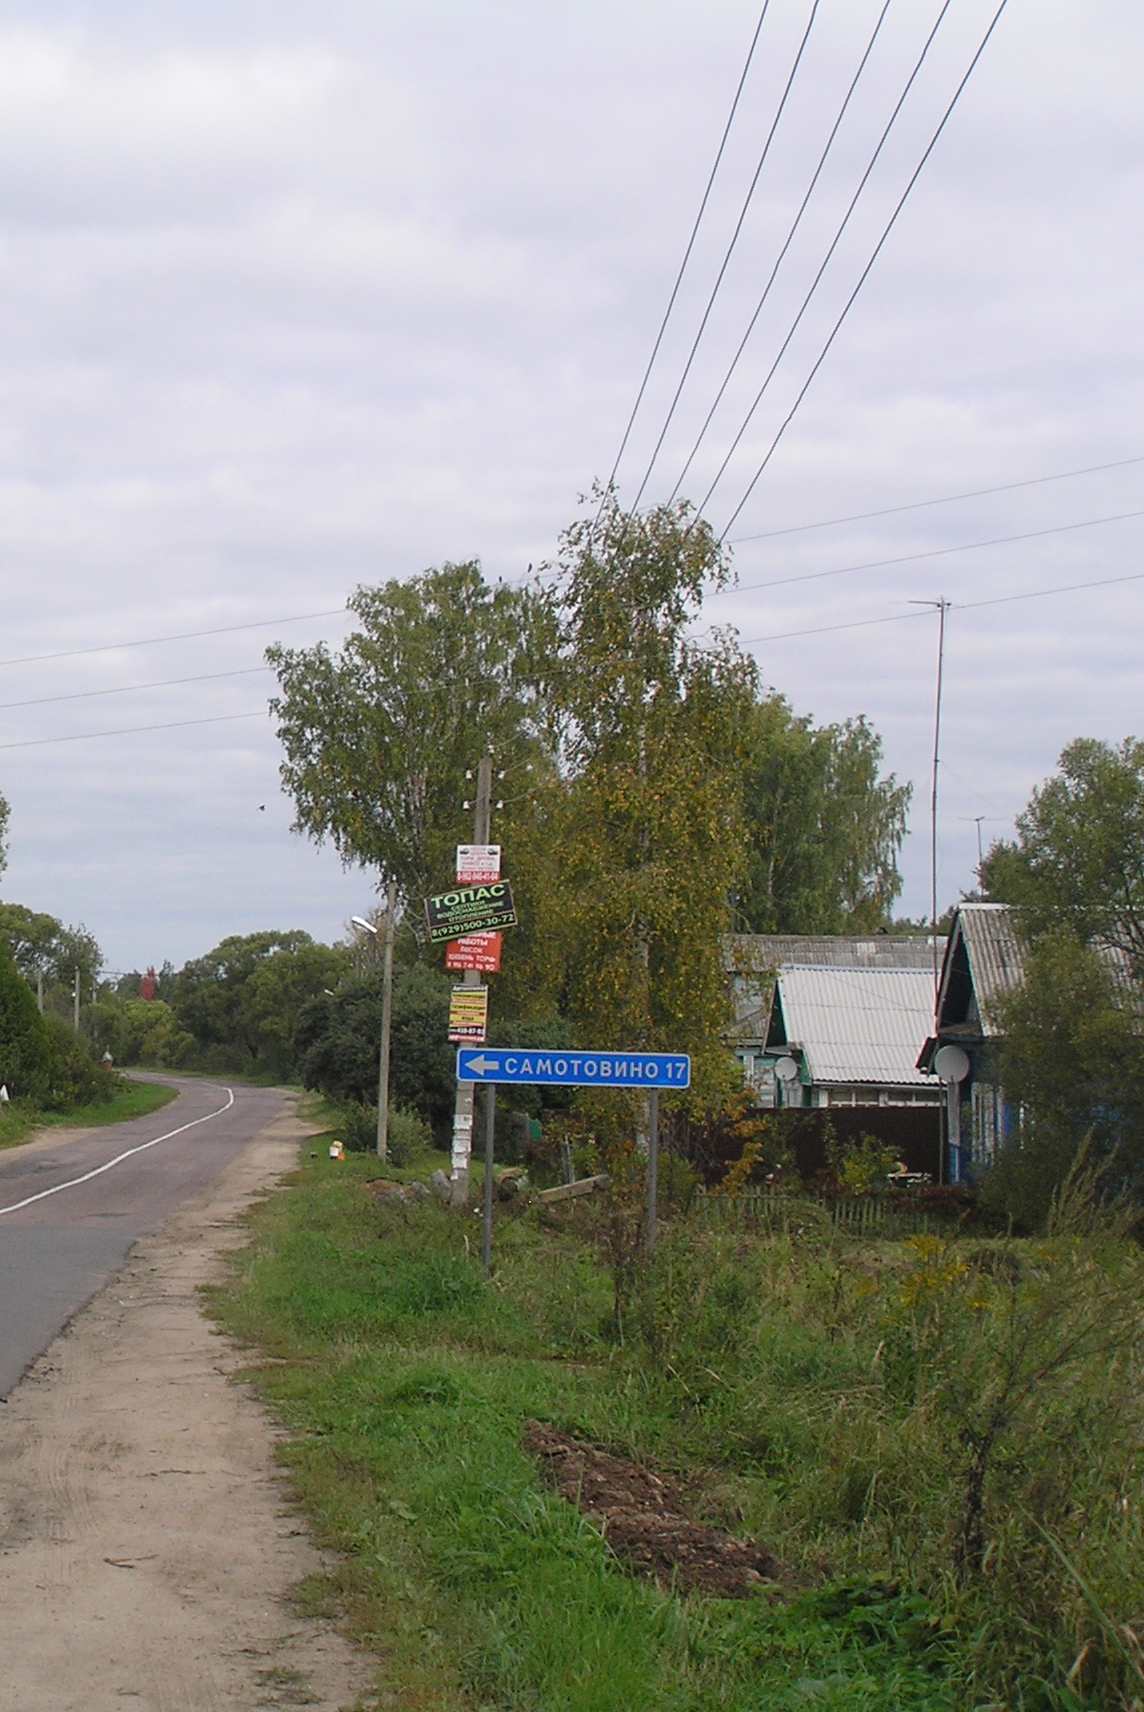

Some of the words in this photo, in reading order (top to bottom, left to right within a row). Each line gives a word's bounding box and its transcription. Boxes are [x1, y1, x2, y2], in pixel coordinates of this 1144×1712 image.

[431, 884, 506, 909] ТОПАС
[431, 914, 515, 937] 8(929)500-30-72
[457, 938, 488, 946] РАБОТЫ
[505, 1058, 659, 1079] САМОТОВИНО
[665, 1063, 687, 1080] 17
